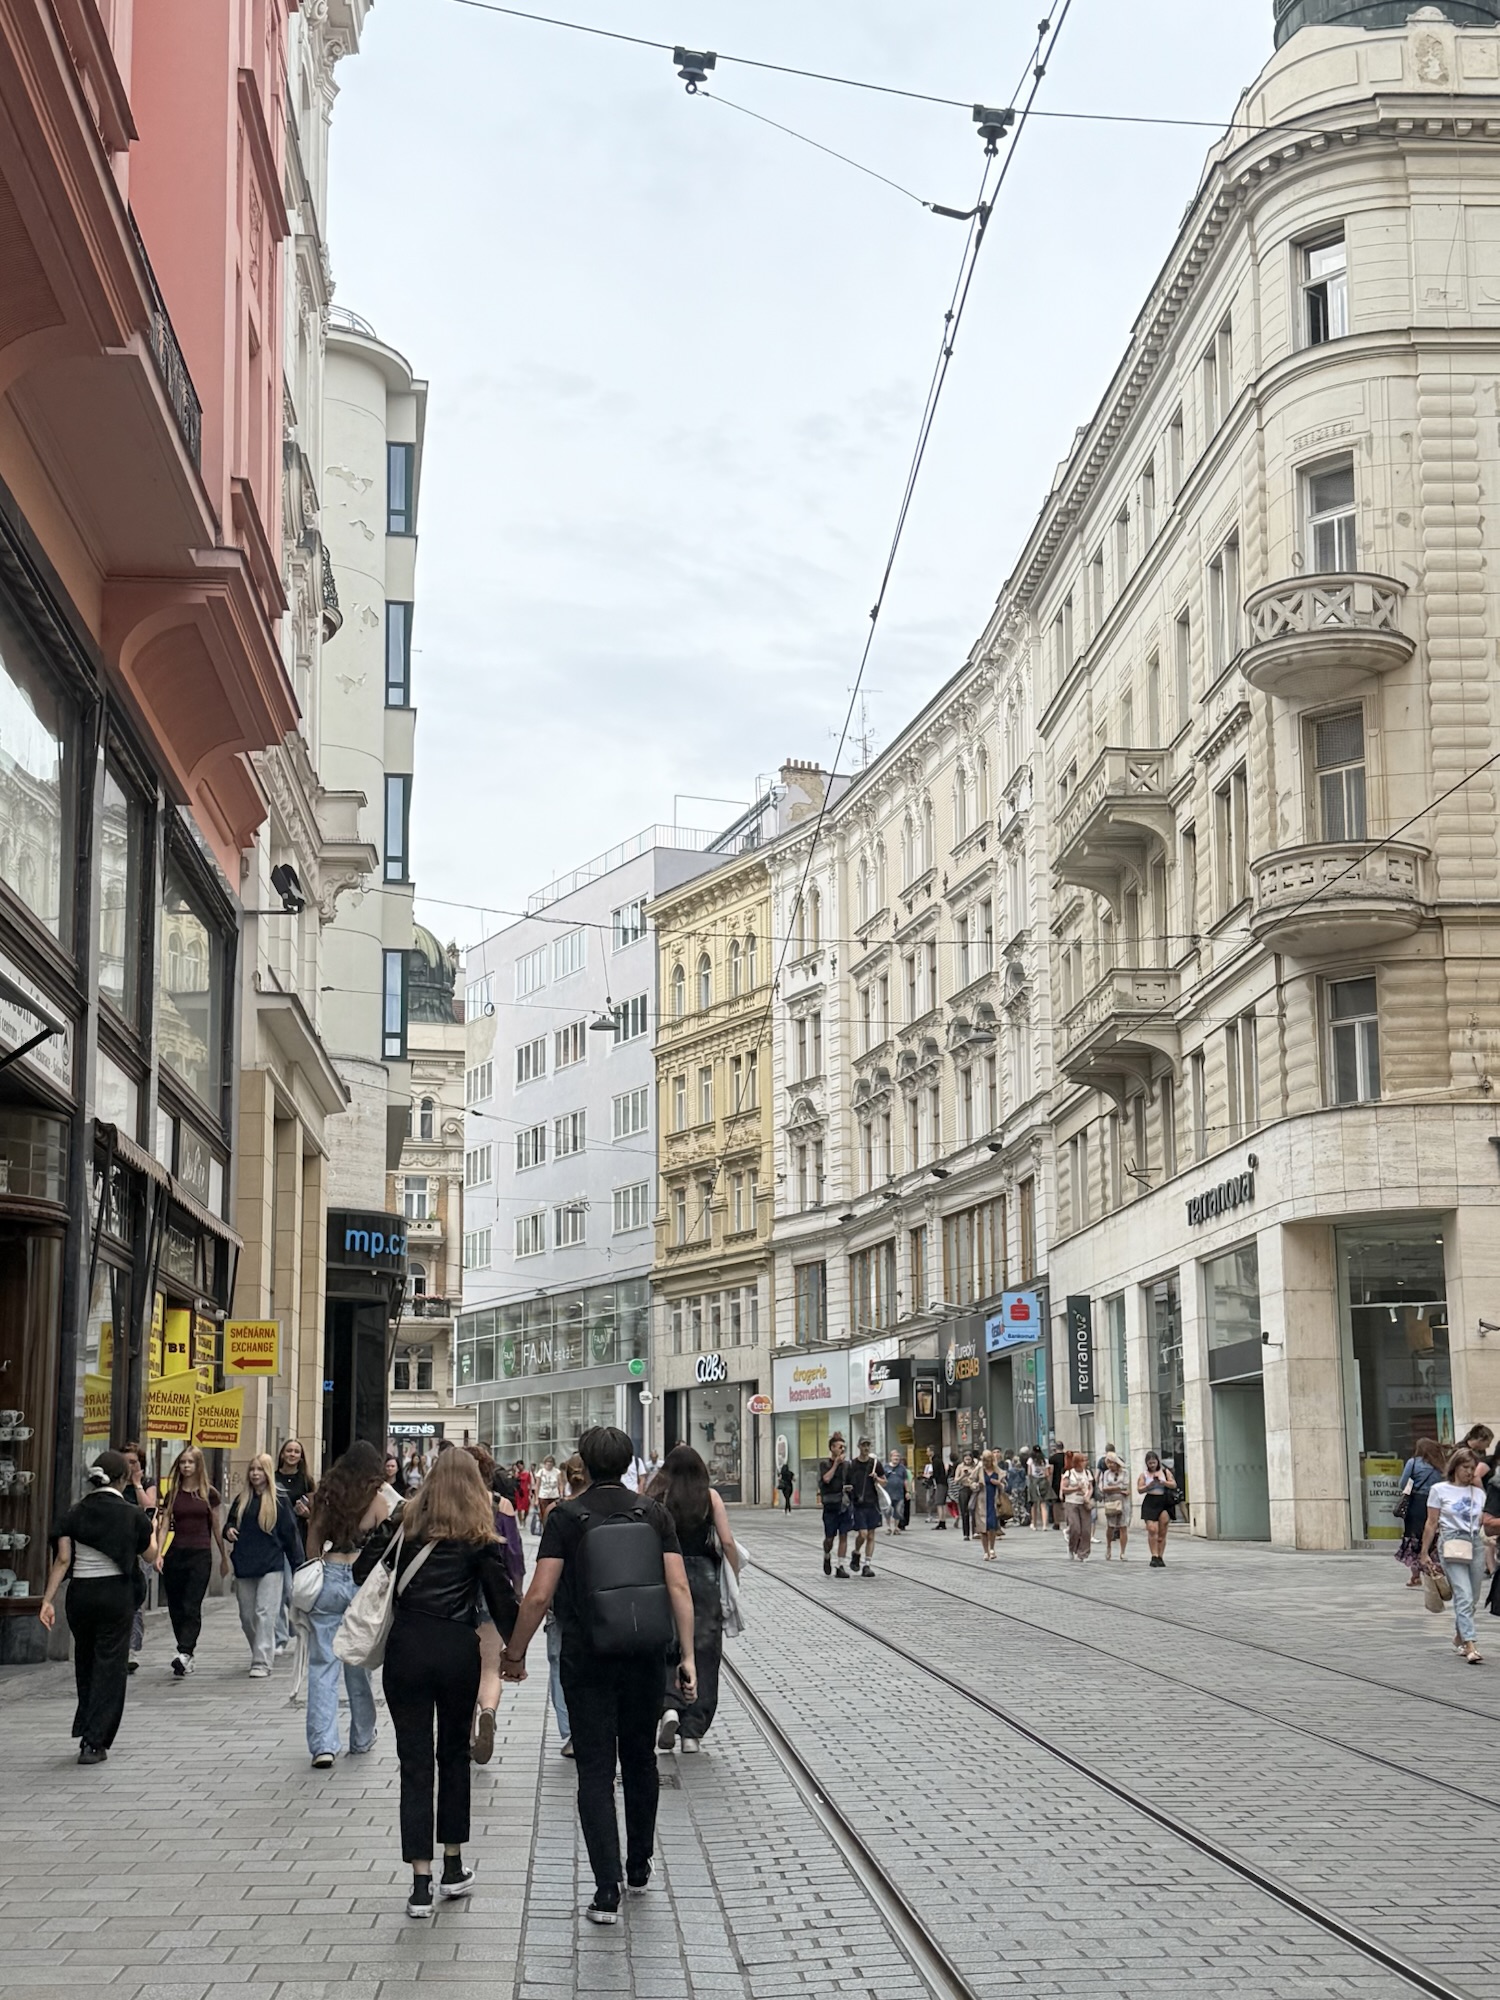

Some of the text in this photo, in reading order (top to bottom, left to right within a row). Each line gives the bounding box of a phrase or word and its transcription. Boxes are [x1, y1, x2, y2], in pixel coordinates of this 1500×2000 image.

[345, 1229, 408, 1259] mp.cz
[230, 1326, 276, 1339] SMĚNÁRNA
[231, 1342, 274, 1353] EXCHANGE
[523, 1340, 552, 1366] FAJN
[793, 1363, 827, 1385] drogerie
[955, 1357, 980, 1380] KEBAB
[789, 1383, 832, 1402] kosmetika
[198, 1405, 240, 1418] SMĚNÁRNA
[200, 1418, 239, 1429] EXCHANGE
